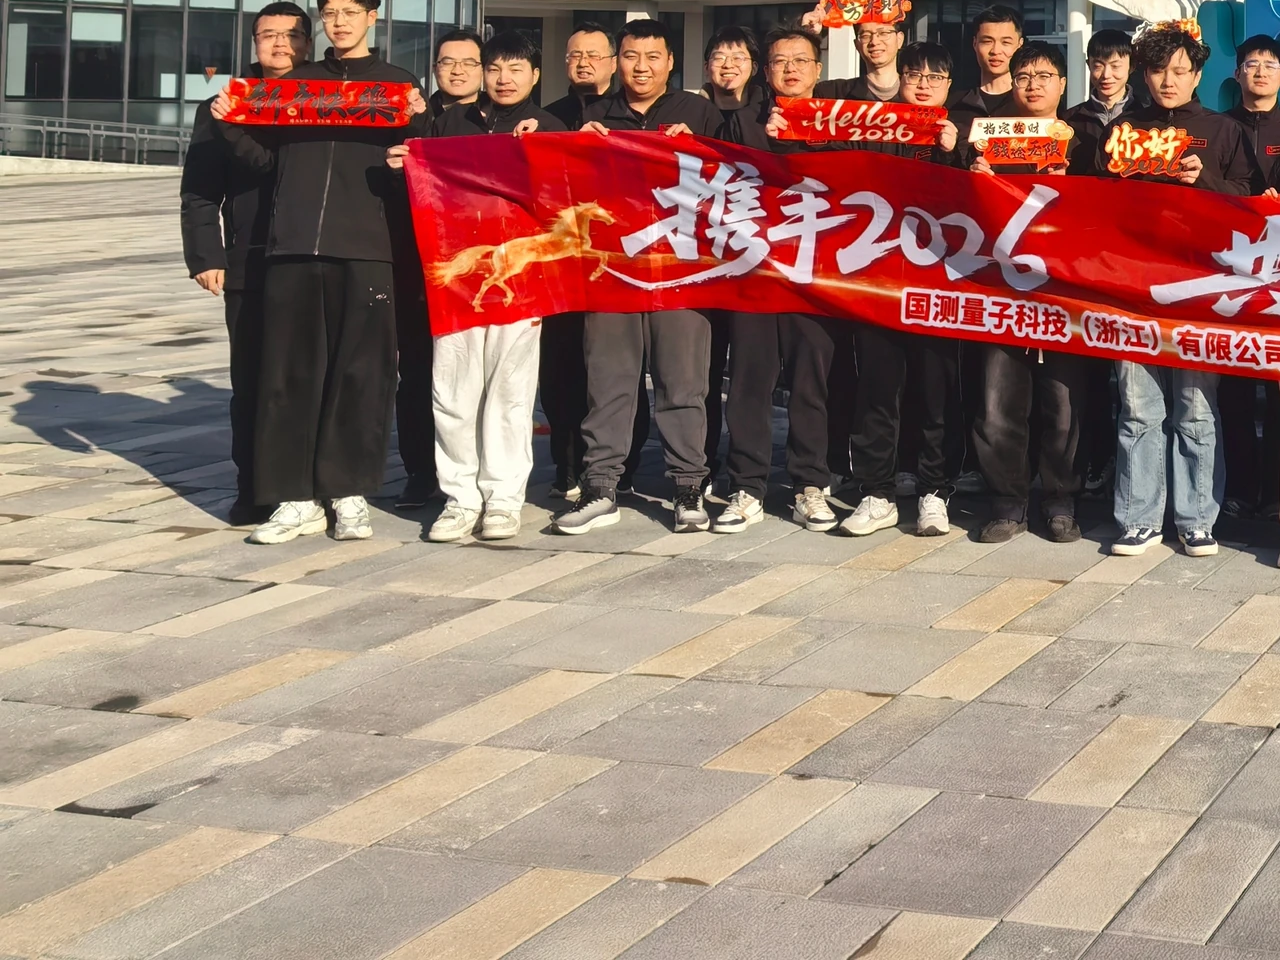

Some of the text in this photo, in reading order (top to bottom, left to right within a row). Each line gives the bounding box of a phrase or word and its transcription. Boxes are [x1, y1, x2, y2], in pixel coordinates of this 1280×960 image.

[802, 99, 898, 136] Hello
[848, 124, 914, 142] 2026
[1105, 122, 1181, 161] 你好
[1121, 148, 1187, 176] 2026
[601, 151, 1059, 292] 携手2026
